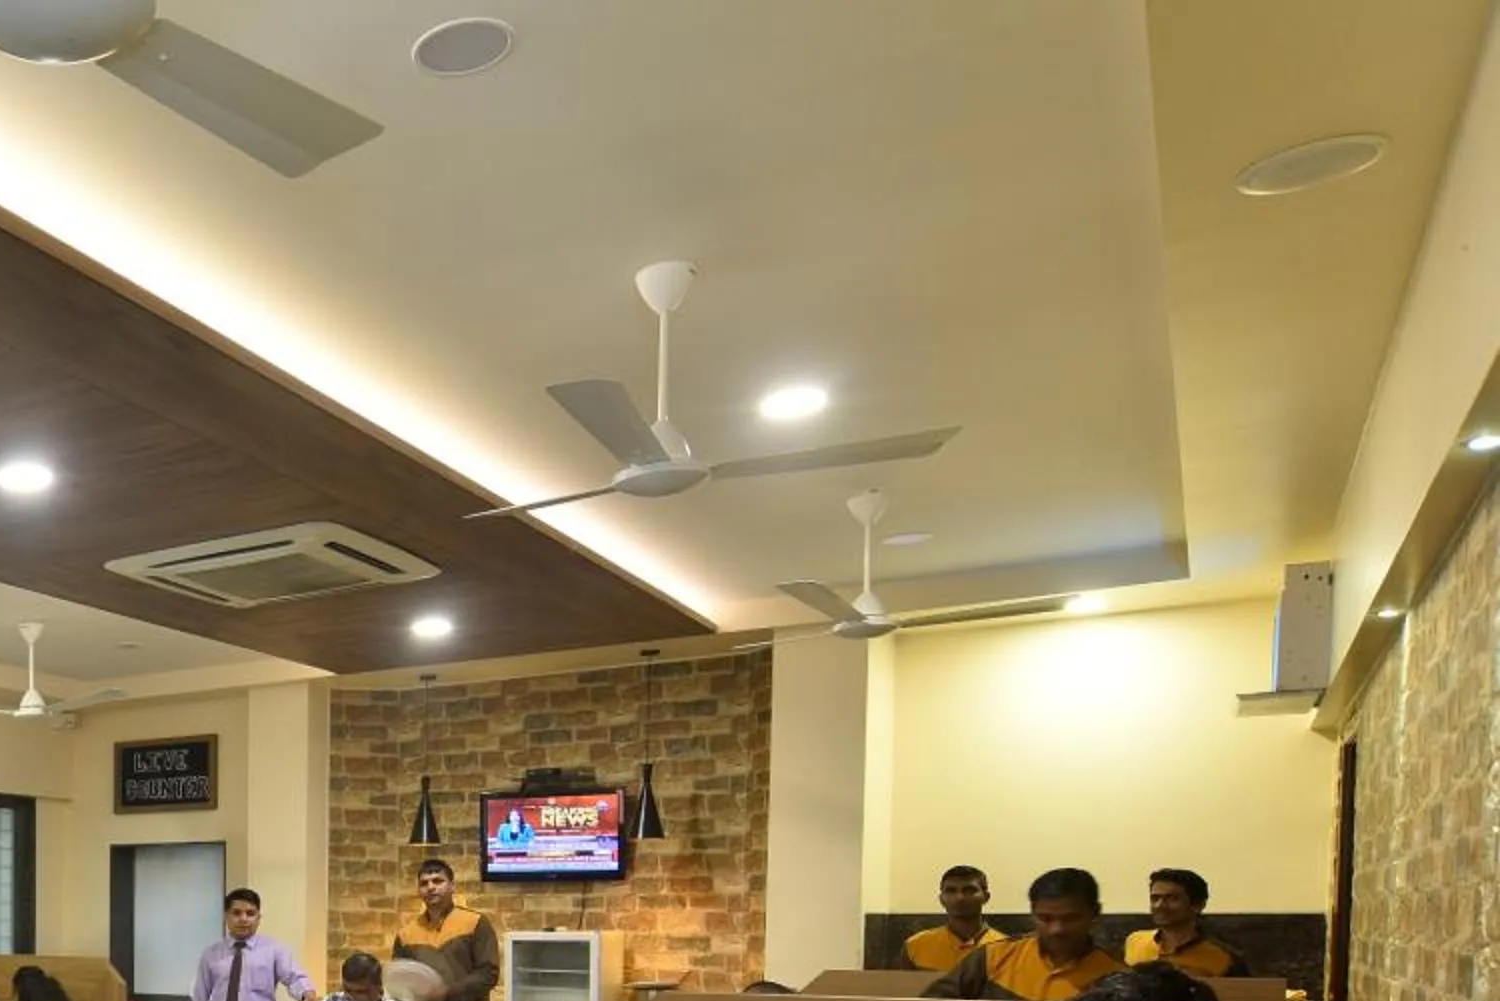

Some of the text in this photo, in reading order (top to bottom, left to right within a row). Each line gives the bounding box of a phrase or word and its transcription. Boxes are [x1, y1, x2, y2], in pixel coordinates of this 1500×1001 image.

[133, 749, 190, 773] LIVE
[124, 775, 210, 800] COUNTER
[541, 813, 599, 828] NEWS
